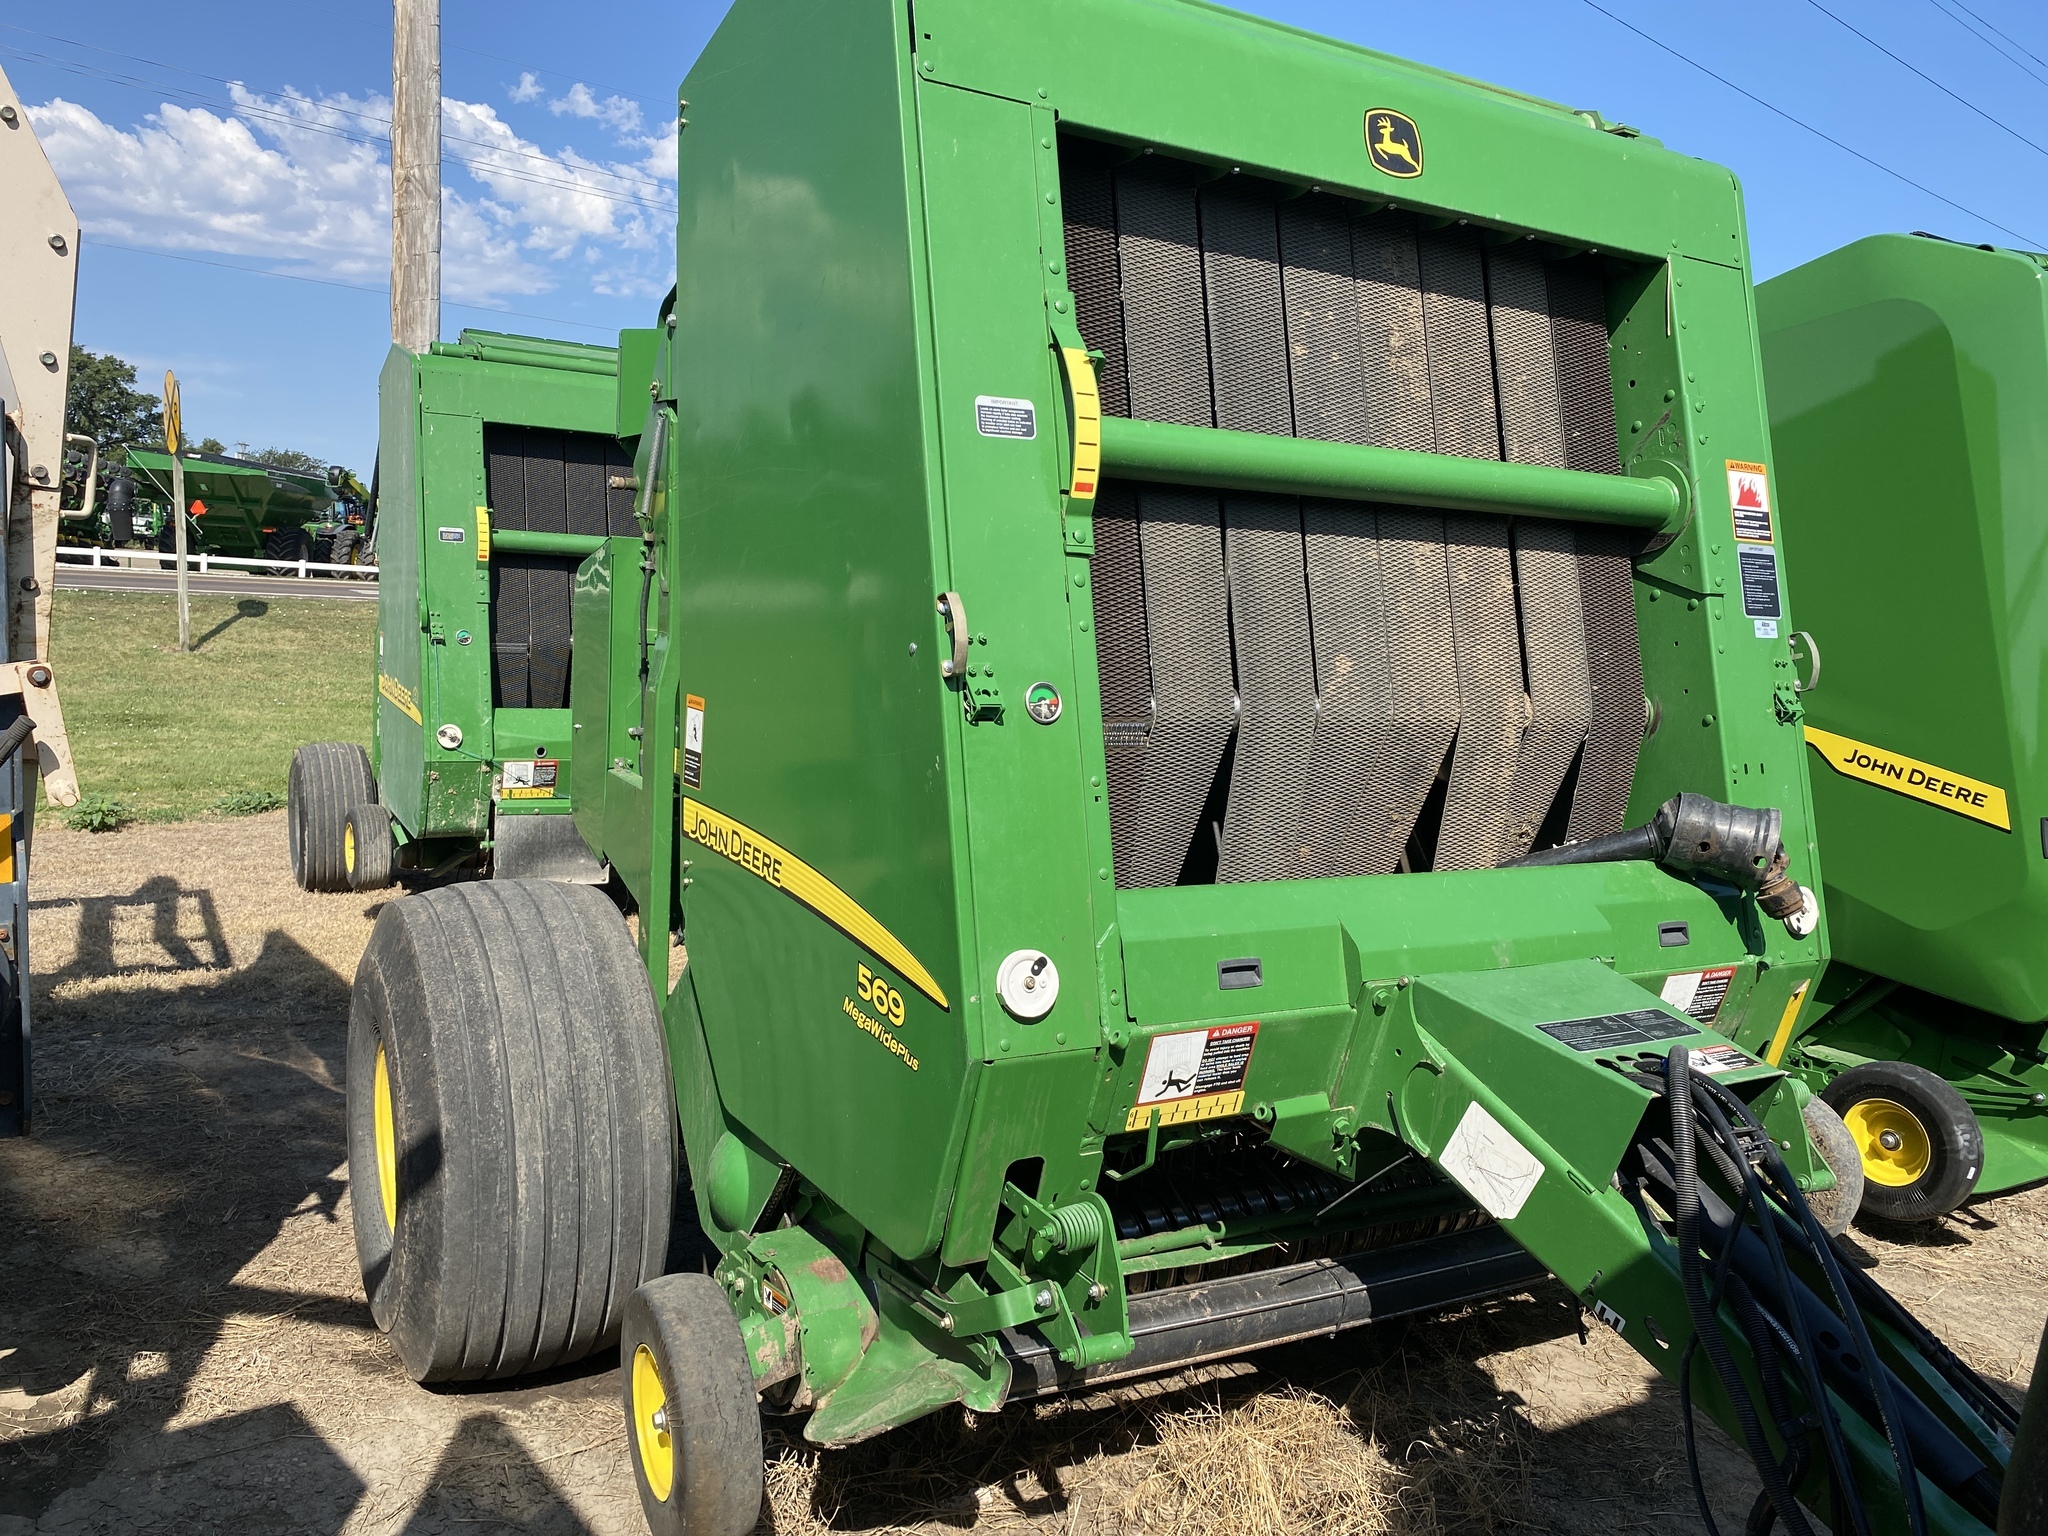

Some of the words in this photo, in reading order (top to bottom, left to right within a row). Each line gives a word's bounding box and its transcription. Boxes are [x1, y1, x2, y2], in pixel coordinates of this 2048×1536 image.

[735, 462, 762, 472] WARNING
[1843, 749, 1904, 780] JOHN
[1907, 768, 1988, 808] DEERE
[690, 812, 729, 854] JOHN
[730, 829, 782, 884] DEERE
[858, 960, 906, 1027] 569
[1710, 970, 1732, 978] DANGER
[843, 996, 919, 1071] MegaWidePlus
[1222, 1026, 1253, 1036] DANGER
